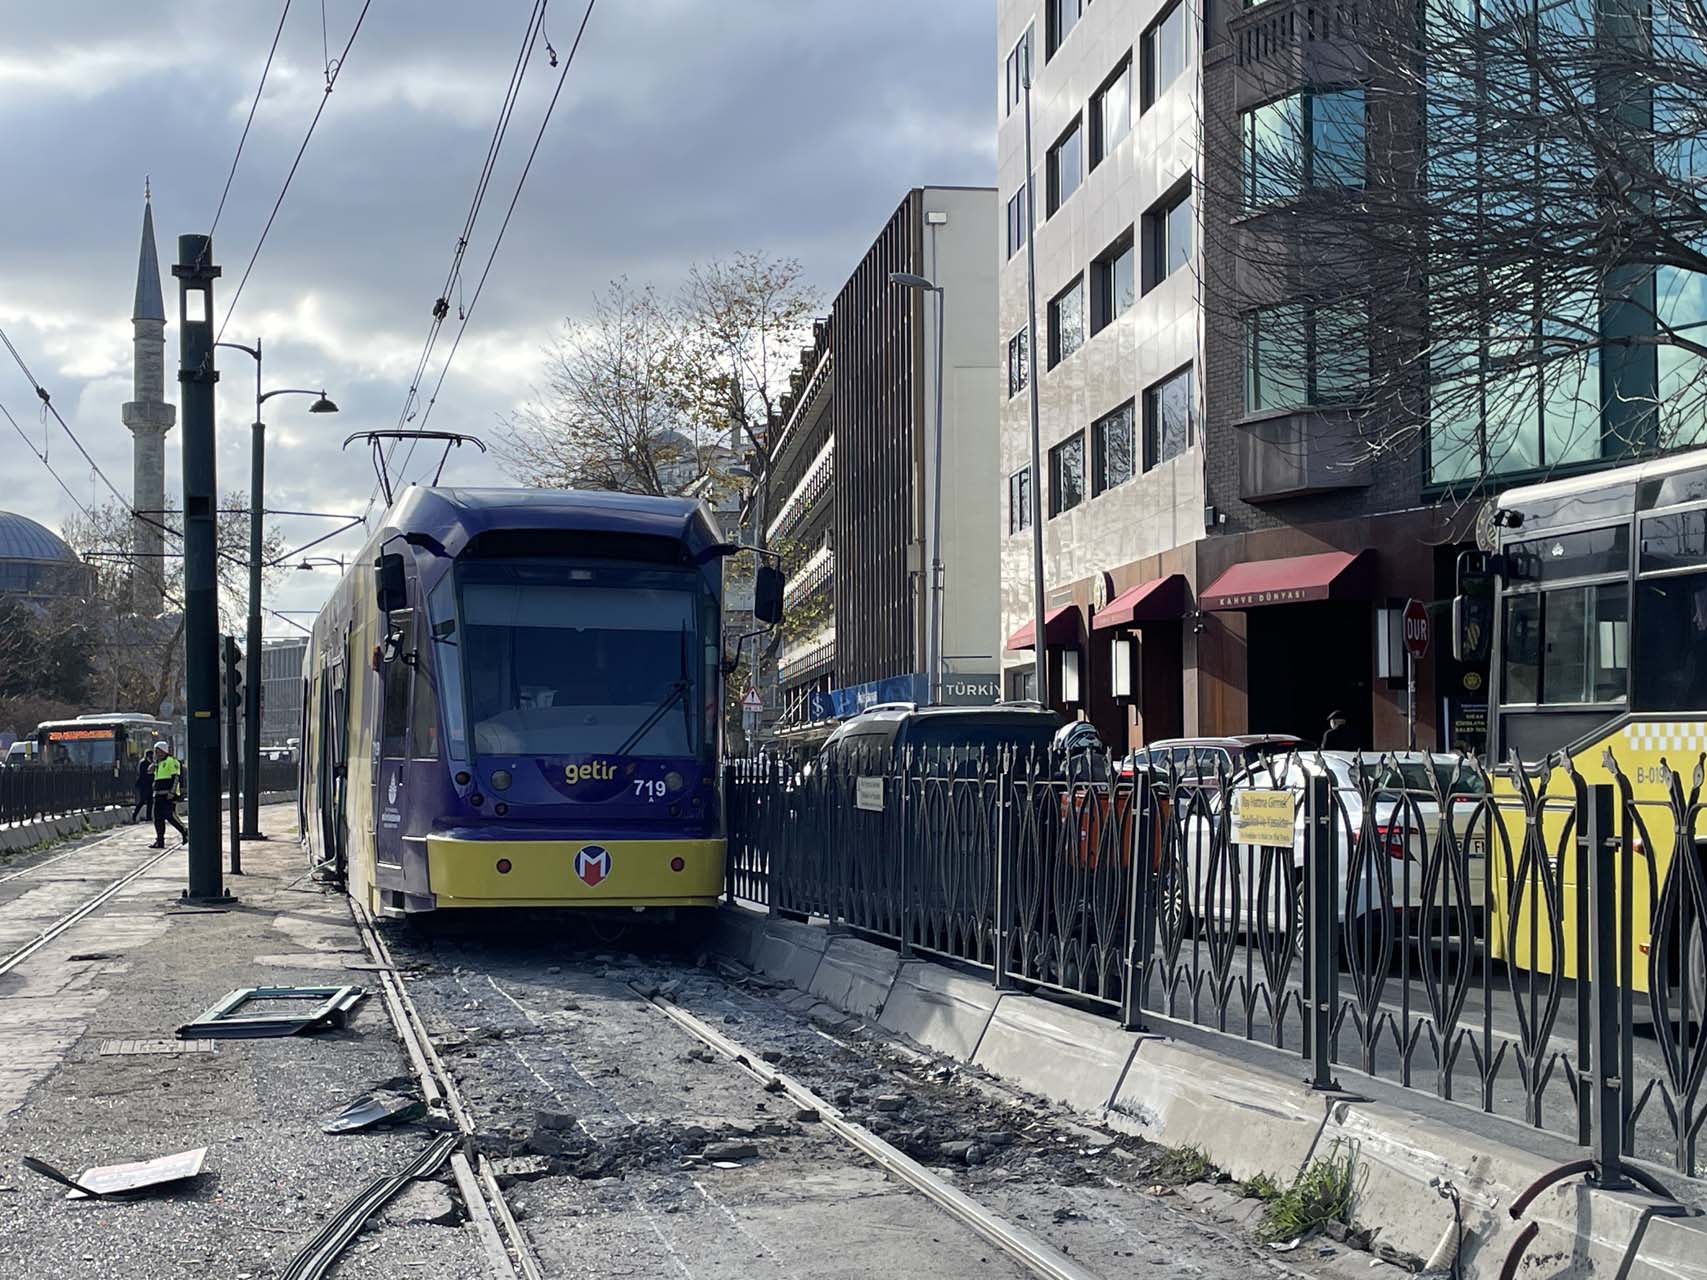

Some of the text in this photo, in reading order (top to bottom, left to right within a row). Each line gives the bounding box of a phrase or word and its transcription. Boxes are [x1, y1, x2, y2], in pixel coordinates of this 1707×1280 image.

[1220, 590, 1305, 606] KAHVE DÜNYASI
[1407, 618, 1427, 641] DUR
[565, 760, 617, 784] getir
[633, 780, 666, 797] 719
